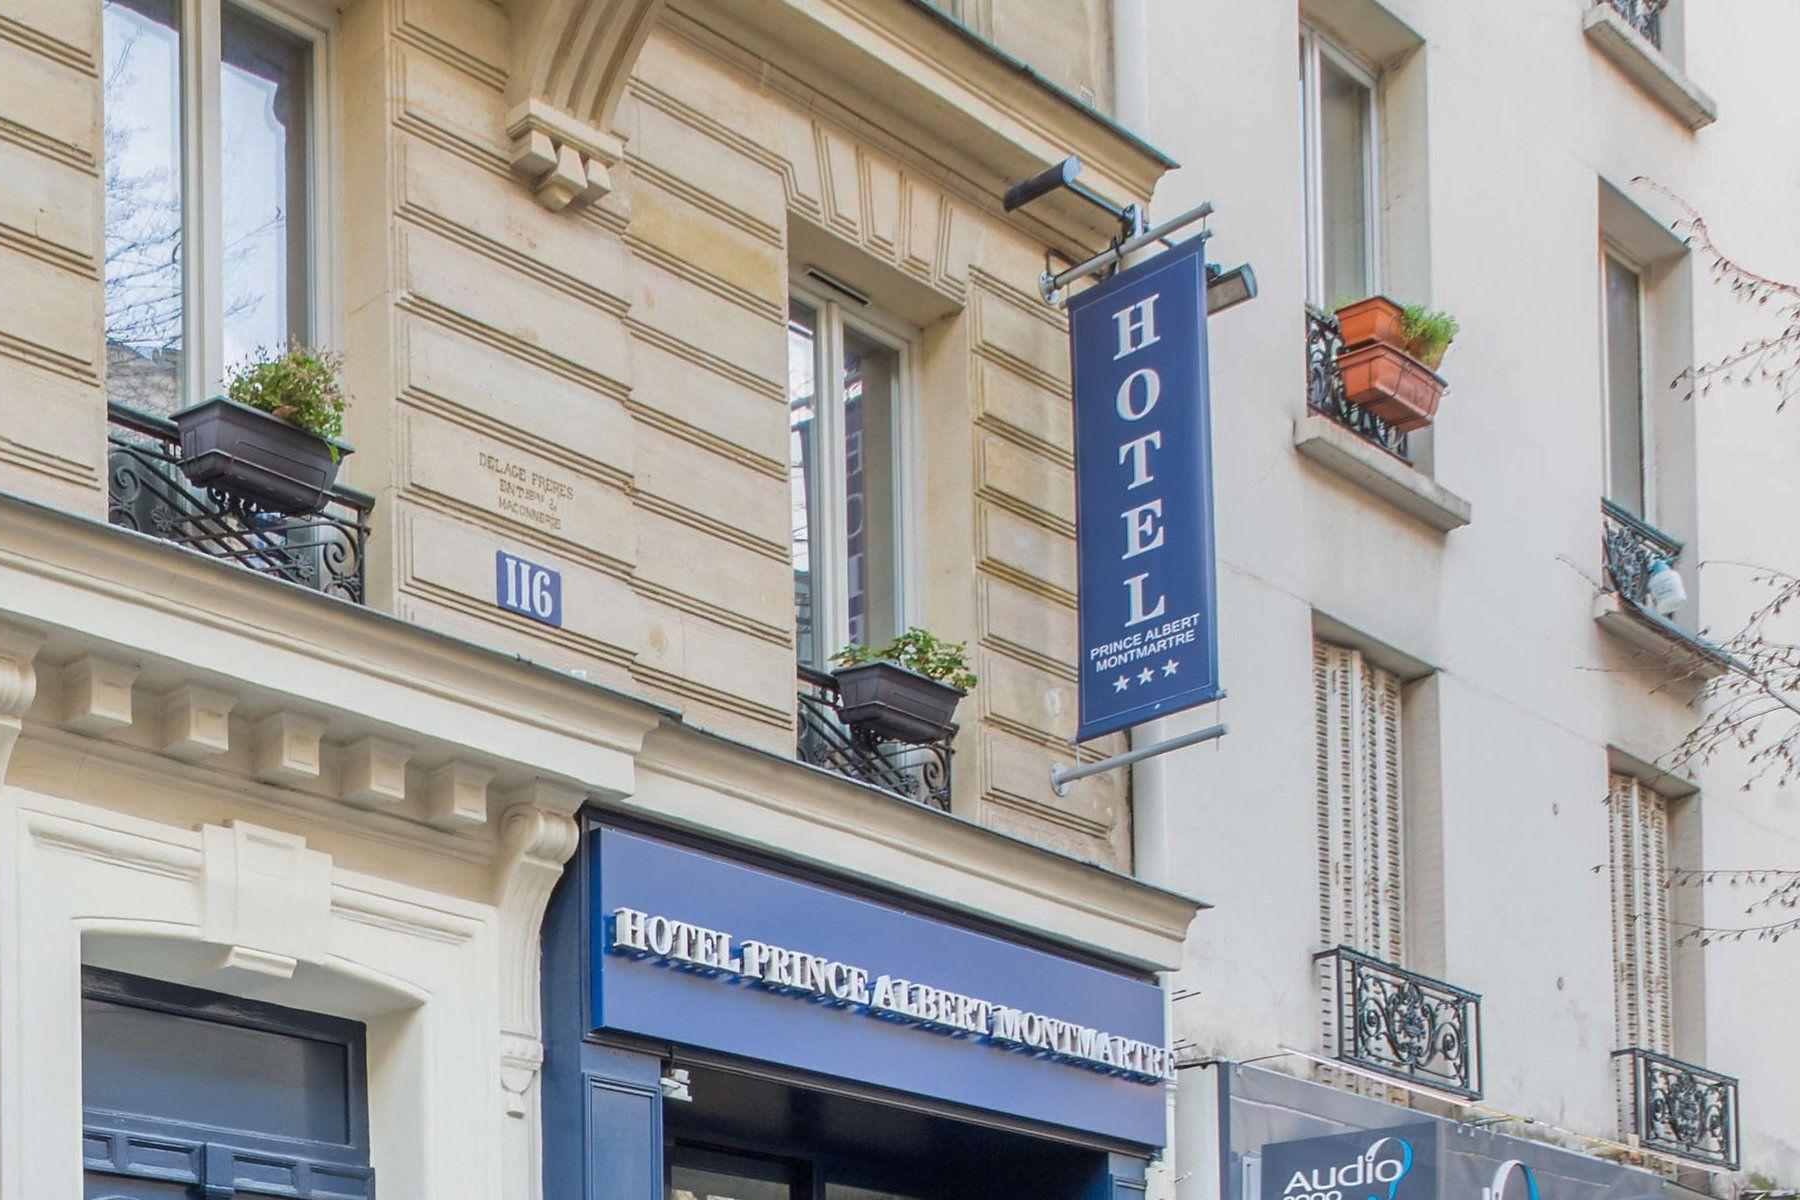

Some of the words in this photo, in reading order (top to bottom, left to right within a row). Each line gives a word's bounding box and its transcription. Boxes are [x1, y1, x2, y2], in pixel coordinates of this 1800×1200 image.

[1113, 293, 1166, 627] HOTEL
[505, 558, 553, 619] 116
[1090, 633, 1142, 660] PRINCE
[1145, 612, 1200, 642] ALBERT
[1096, 630, 1195, 673] MONTMARTRE
[613, 907, 740, 973] HOTEL
[740, 940, 869, 1005] PRINCE
[869, 974, 992, 1034] ALBERT
[992, 1005, 1178, 1080] MONTMARTRE
